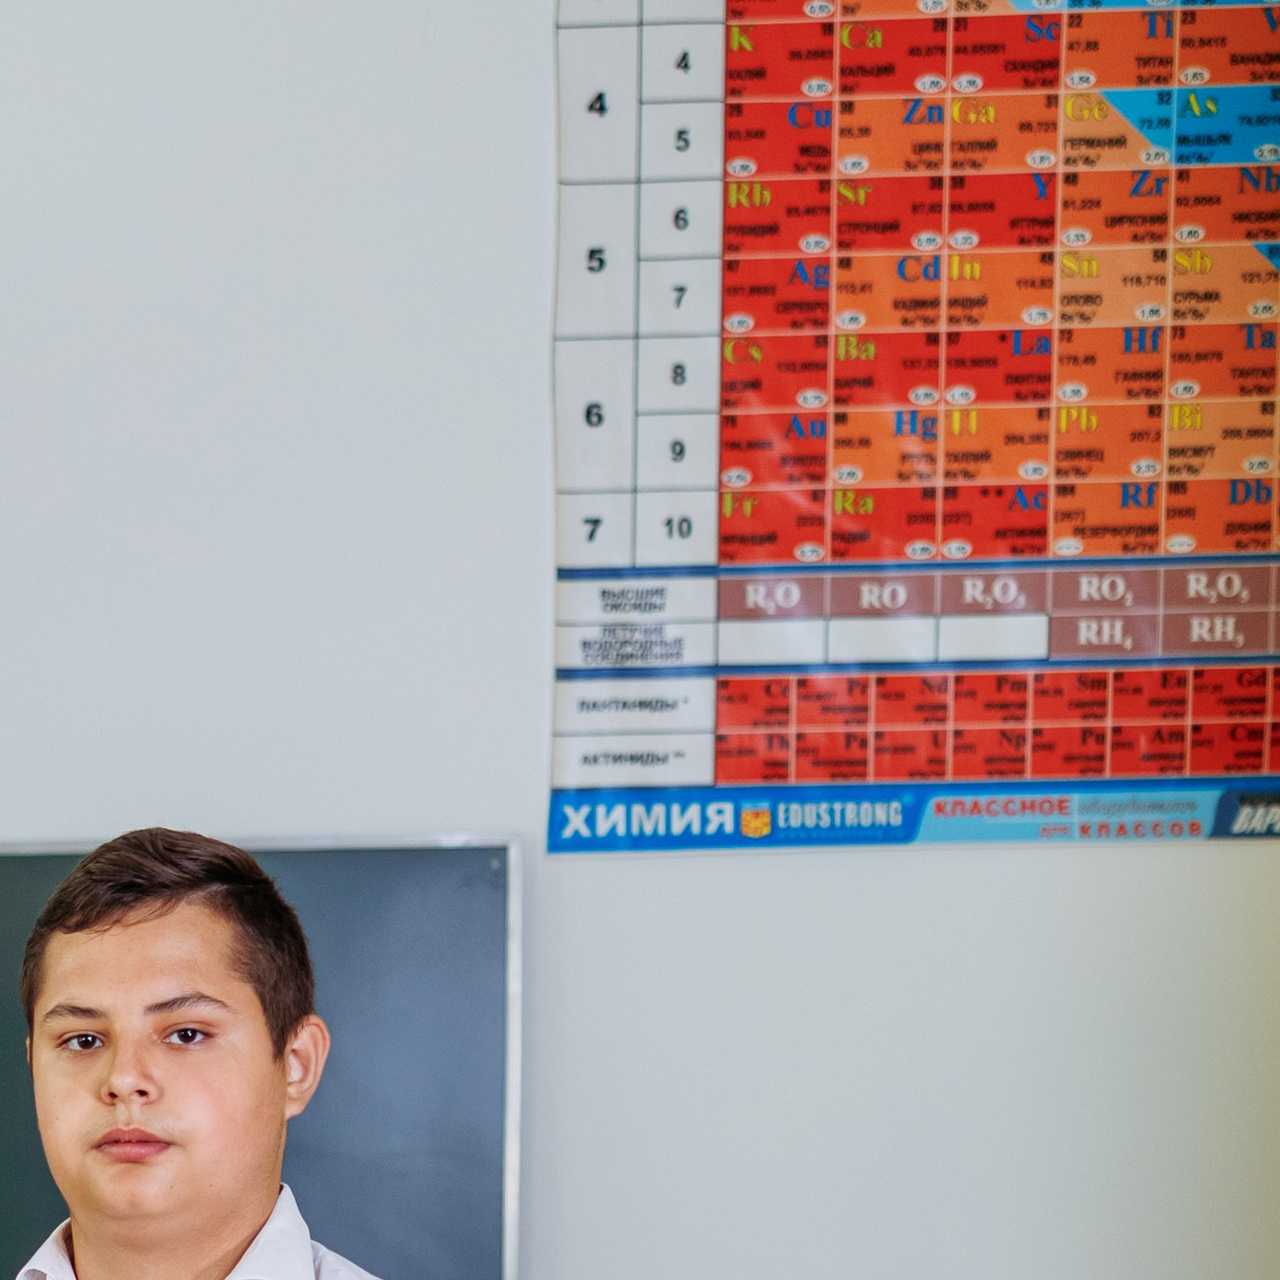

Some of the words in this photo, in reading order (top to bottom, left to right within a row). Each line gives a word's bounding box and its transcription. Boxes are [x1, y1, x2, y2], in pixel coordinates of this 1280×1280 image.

[840, 22, 883, 48] Ca
[1025, 15, 1060, 43] Sc
[1141, 11, 1173, 38] Ti
[730, 25, 754, 51] K
[676, 52, 691, 73] 4
[588, 92, 608, 117] 4
[787, 101, 832, 129] Cu
[902, 98, 944, 125] Zn
[952, 97, 996, 124] Ga
[1065, 94, 1108, 121] Ge
[1180, 93, 1218, 118] As
[675, 129, 690, 152] 5
[728, 180, 771, 208] Rb
[838, 181, 872, 206] Sr
[1031, 173, 1055, 199] Y
[1130, 170, 1169, 197] Zr
[674, 208, 689, 230] 6
[587, 248, 606, 272] 5
[897, 254, 940, 282] Cd
[950, 253, 981, 281] In
[1061, 252, 1098, 278] Sn
[1174, 248, 1212, 275] Sb
[789, 260, 829, 290] Ag
[672, 287, 687, 308] 7
[837, 333, 876, 361] Ba
[1123, 327, 1164, 353] Hf
[1240, 324, 1276, 349] Ta
[723, 337, 763, 365] Cs
[671, 363, 686, 386] 8
[585, 403, 604, 427] 6
[784, 414, 827, 439] Au
[895, 410, 937, 441] Hg
[1060, 407, 1097, 434] Pb
[1171, 404, 1202, 430] Bi
[671, 441, 685, 462] 9
[722, 491, 758, 519] Fr
[834, 489, 874, 515] Ra
[1008, 486, 1047, 511] Ac
[1121, 482, 1160, 508] Rf
[1230, 479, 1273, 505] Db
[583, 518, 603, 542] 7
[664, 518, 692, 538] 10
[859, 582, 907, 610] RO
[561, 801, 735, 839] ХИМИЯ
[777, 800, 902, 827] EDUSTRONG
[933, 796, 1071, 819] КЛАССНОЕ
[1078, 820, 1202, 839] КЛАССОВ
